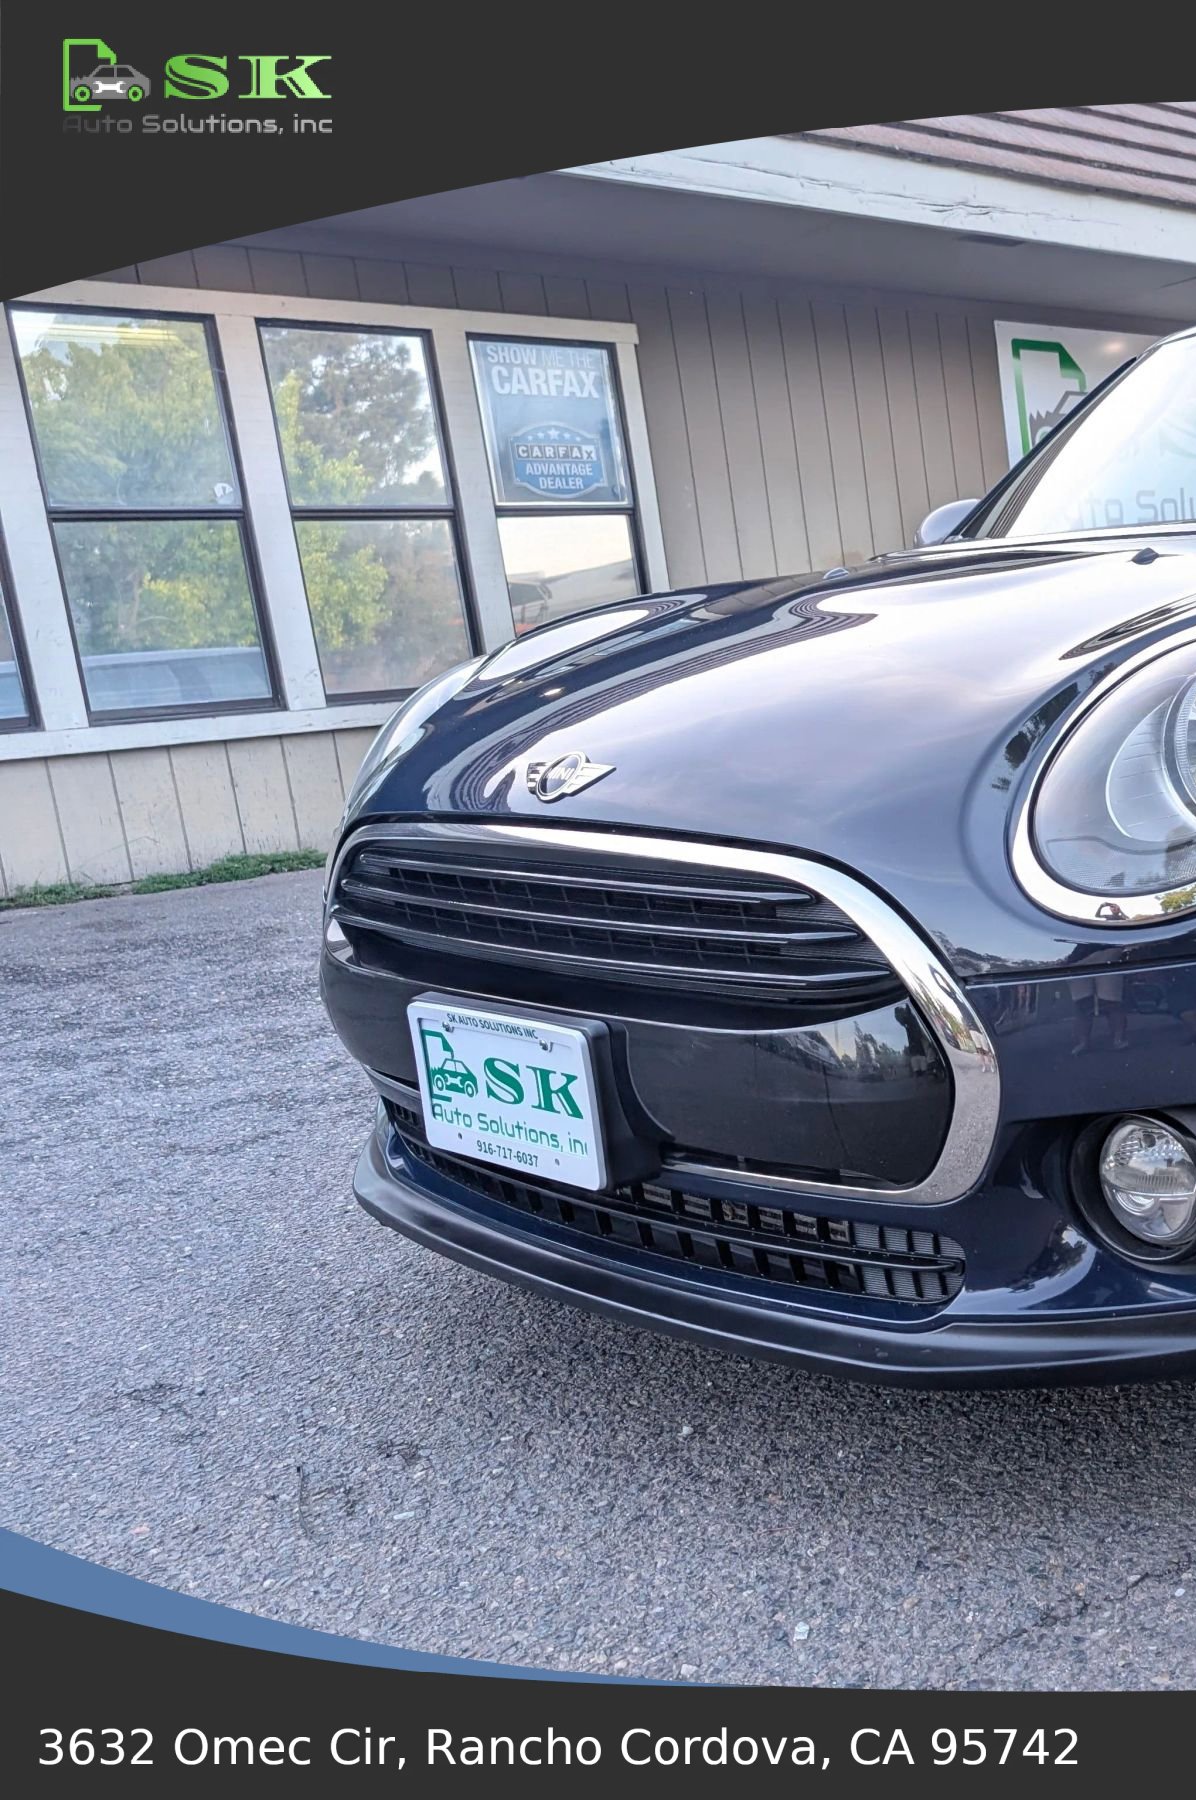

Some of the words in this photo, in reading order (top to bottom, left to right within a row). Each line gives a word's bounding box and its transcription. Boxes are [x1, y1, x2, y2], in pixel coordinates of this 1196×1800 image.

[487, 346, 537, 366] SHOW
[542, 350, 564, 368] ME
[569, 350, 594, 368] THE
[491, 366, 600, 398] CARFAX
[517, 445, 597, 460] CARFAX
[525, 463, 593, 476] ADVANTAGE
[539, 477, 584, 489] DEALER
[447, 1013, 458, 1024] SK
[458, 1016, 479, 1029] AUTO
[479, 1019, 524, 1036] SOLUTIONS
[524, 1029, 539, 1040] INC
[483, 1057, 584, 1120] SK
[432, 1103, 473, 1128] Auto
[478, 1113, 564, 1153] Solutions,
[477, 1140, 539, 1167] 916-717-6037
